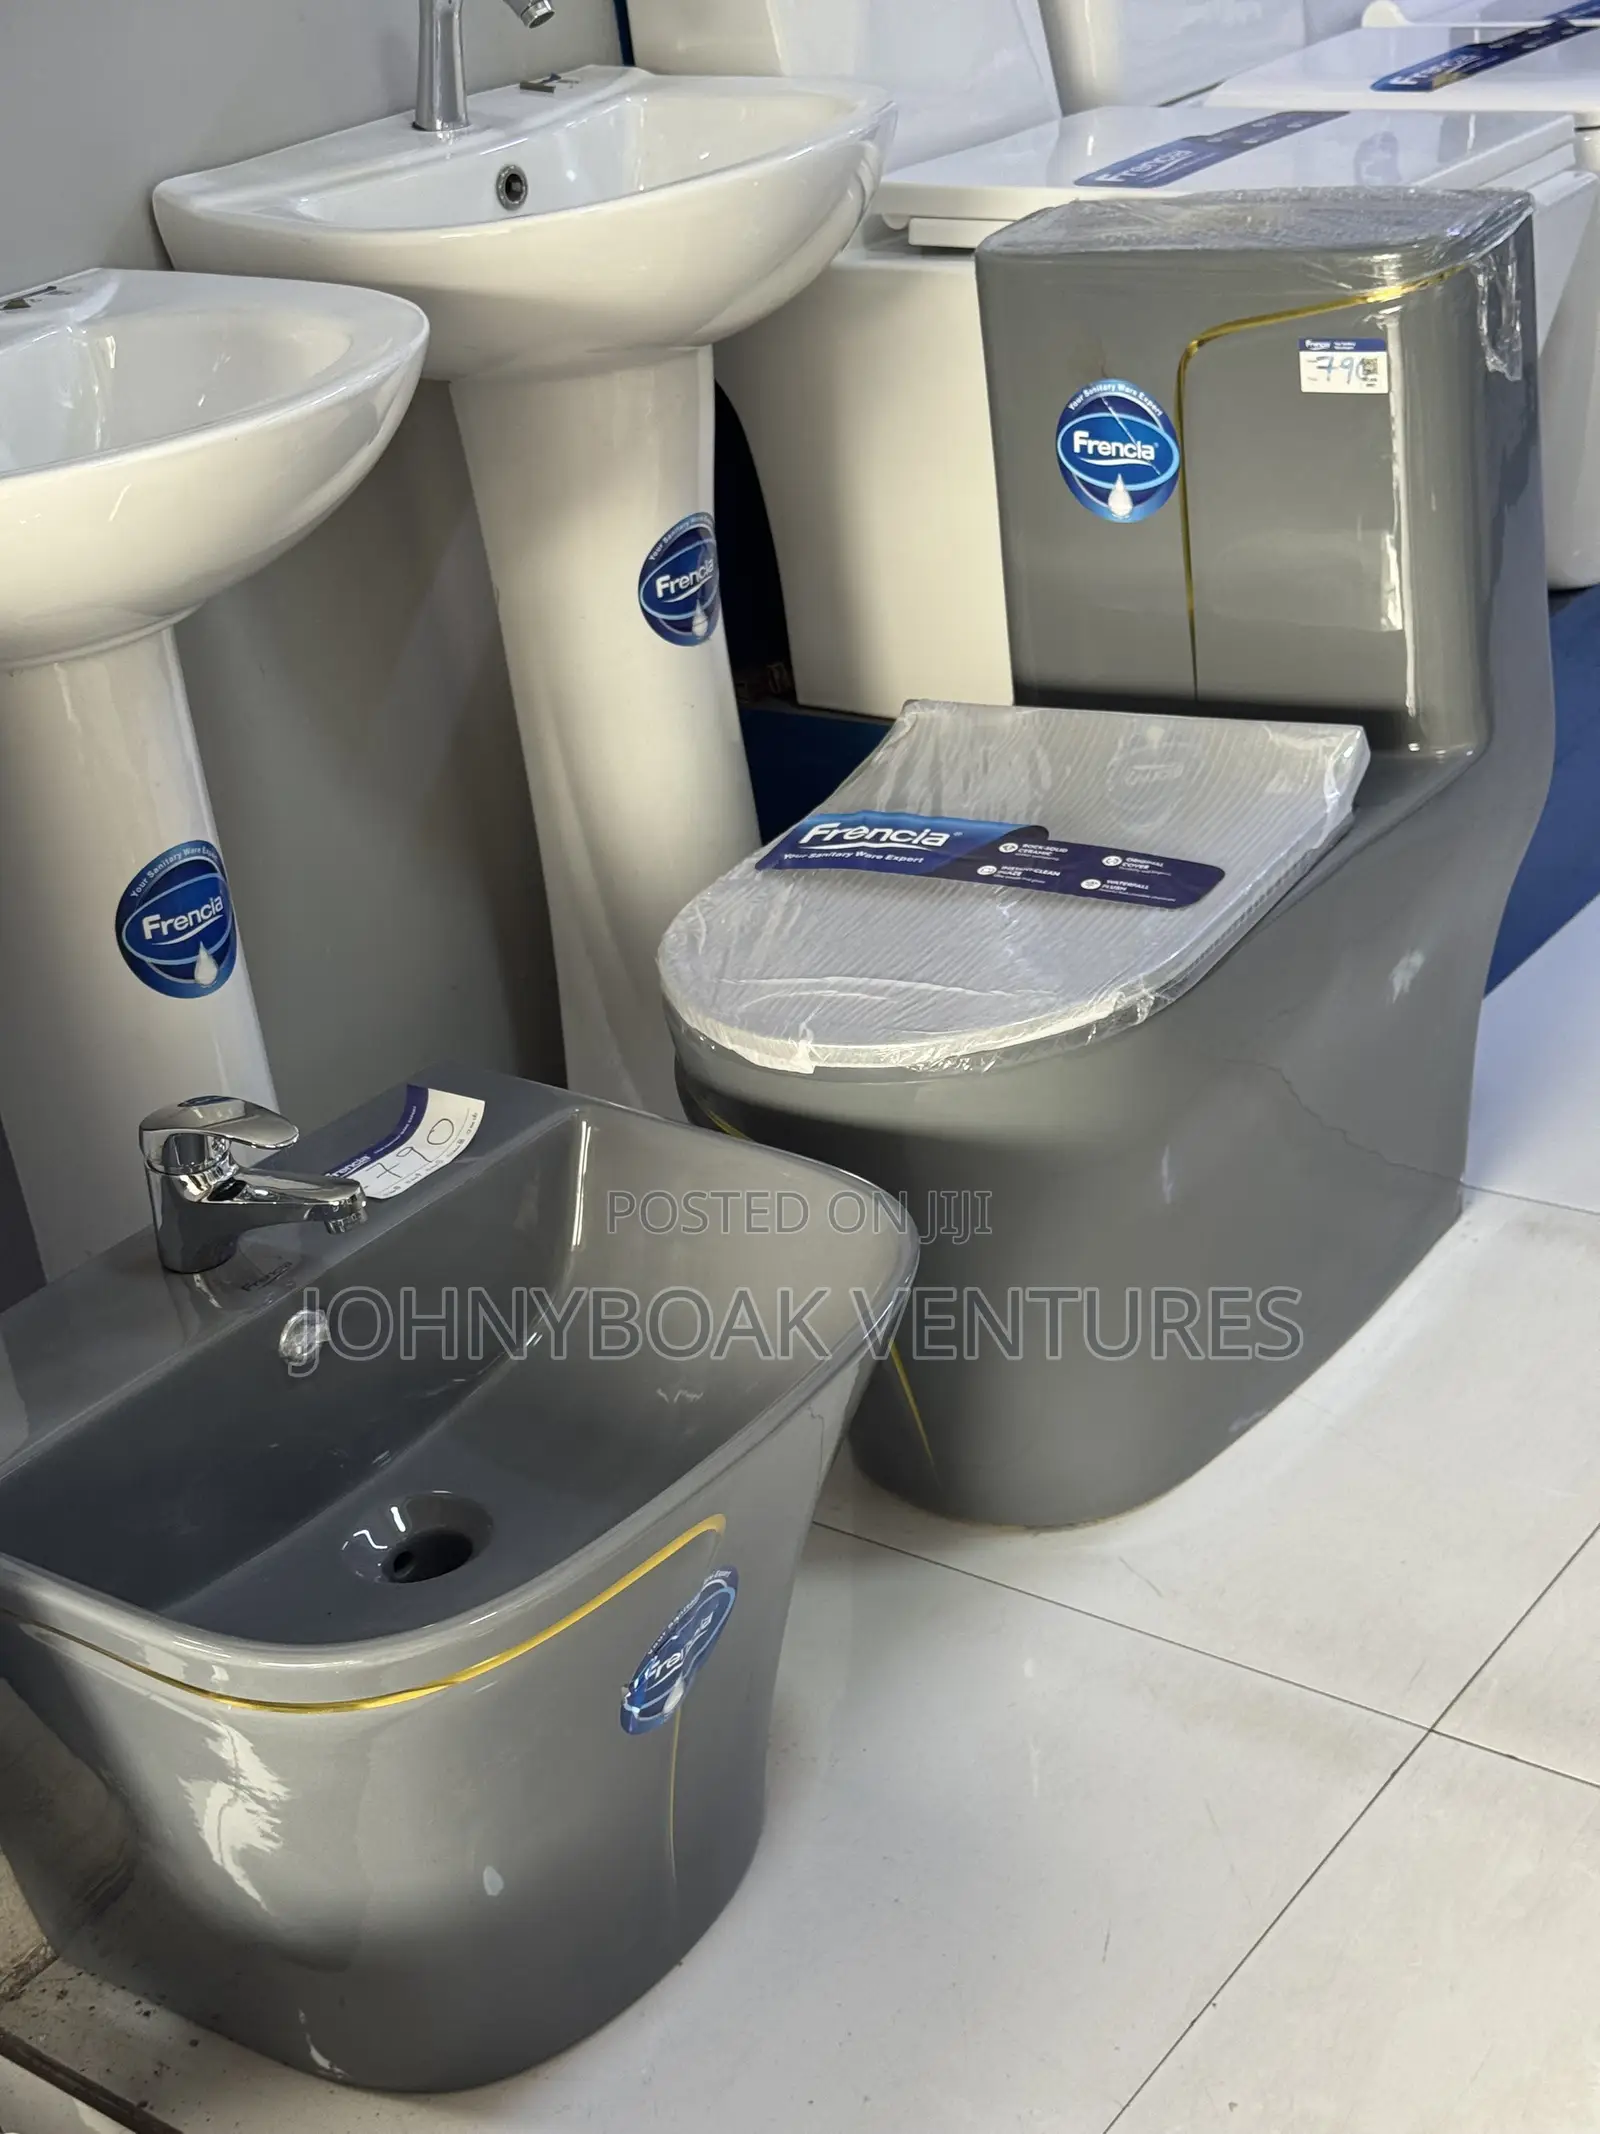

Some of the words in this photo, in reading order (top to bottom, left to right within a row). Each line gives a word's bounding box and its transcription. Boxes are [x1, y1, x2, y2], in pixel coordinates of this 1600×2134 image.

[1073, 430, 1156, 461] Frencia
[655, 558, 714, 598] Frencia
[799, 822, 951, 847] Frencia
[130, 878, 148, 898] Your
[147, 852, 182, 879] Sanitary
[182, 847, 201, 856] Ware
[808, 851, 852, 859] Sanitary
[855, 850, 883, 860] Ware
[884, 854, 925, 864] Expert
[141, 895, 224, 940] Frencia
[325, 1154, 372, 1178] rencia
